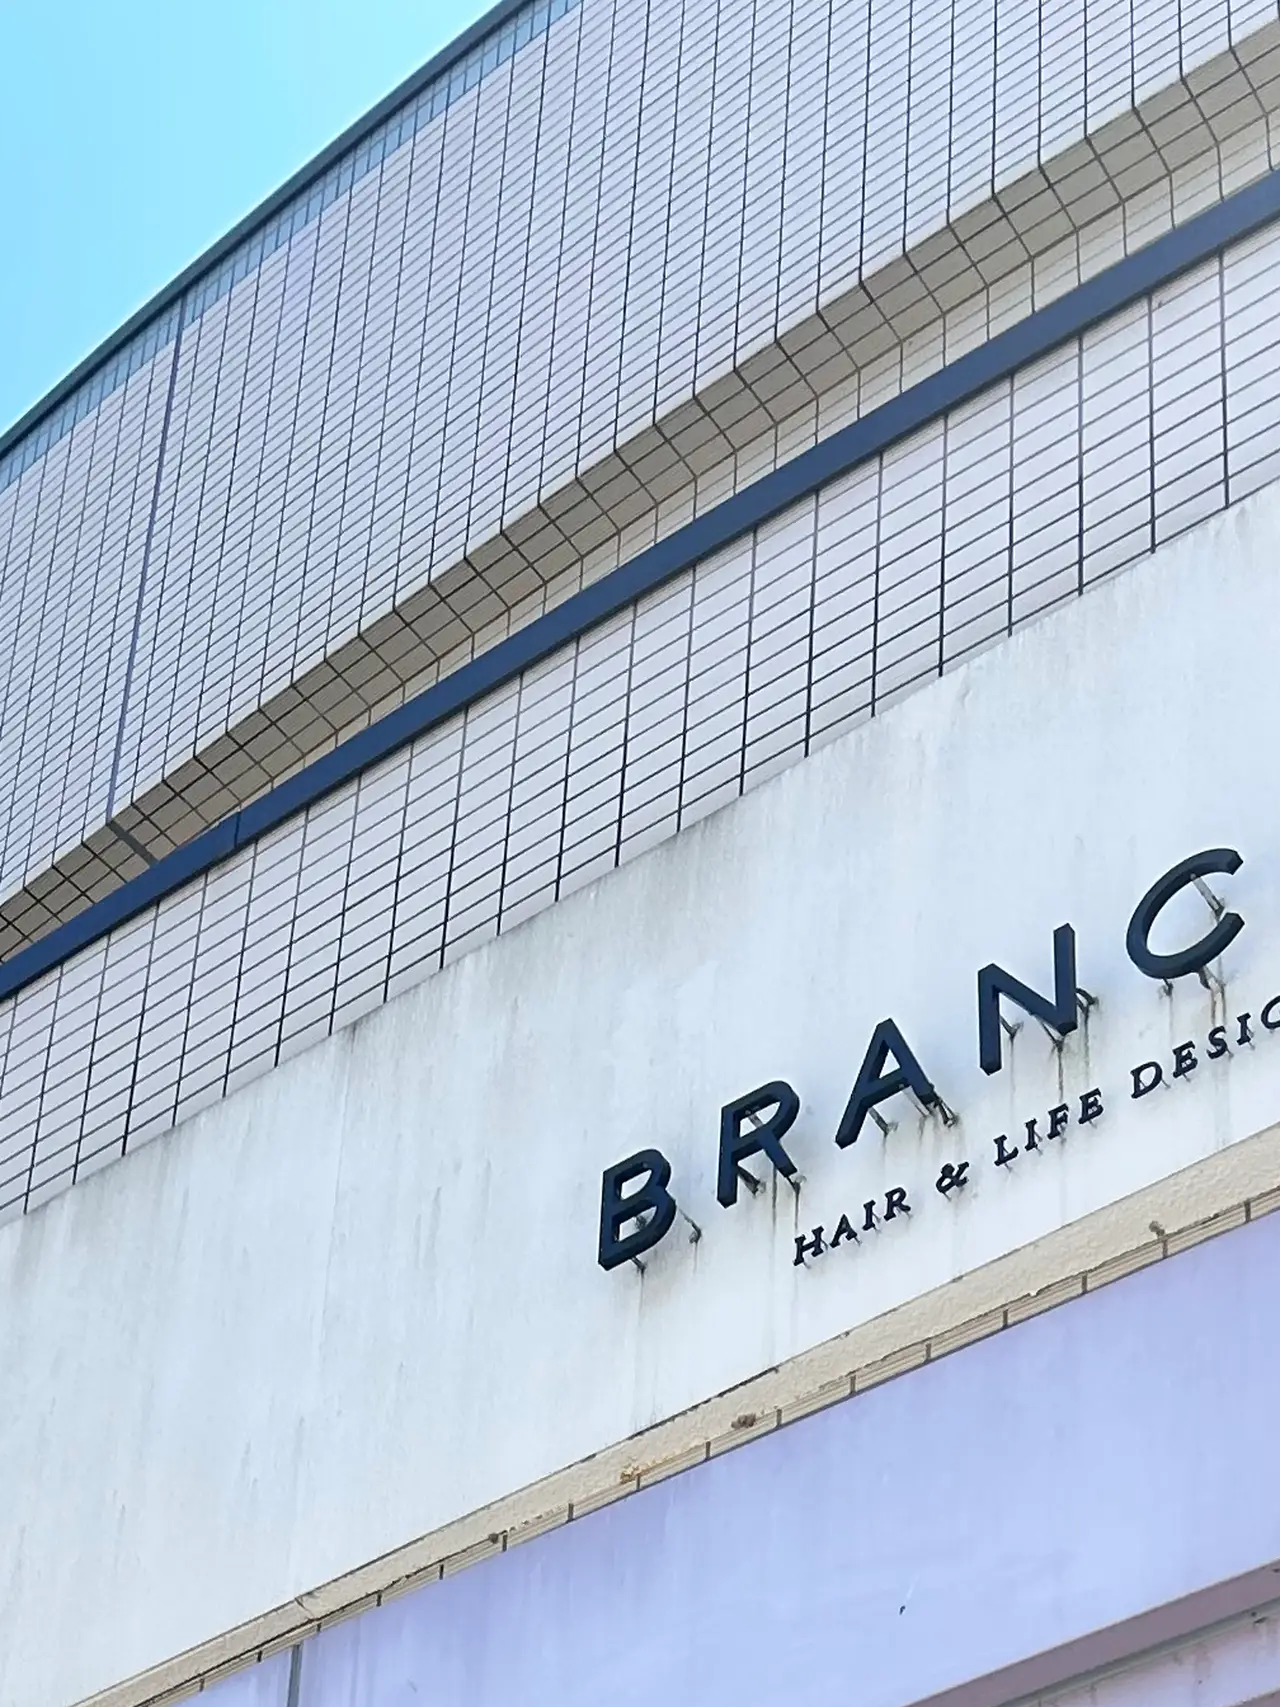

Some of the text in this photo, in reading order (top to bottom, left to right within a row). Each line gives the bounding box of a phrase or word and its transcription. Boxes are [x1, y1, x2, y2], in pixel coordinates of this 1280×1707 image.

[793, 1187, 911, 1265] HAIR
[935, 1161, 970, 1195] &
[993, 1088, 1105, 1167] LIFE
